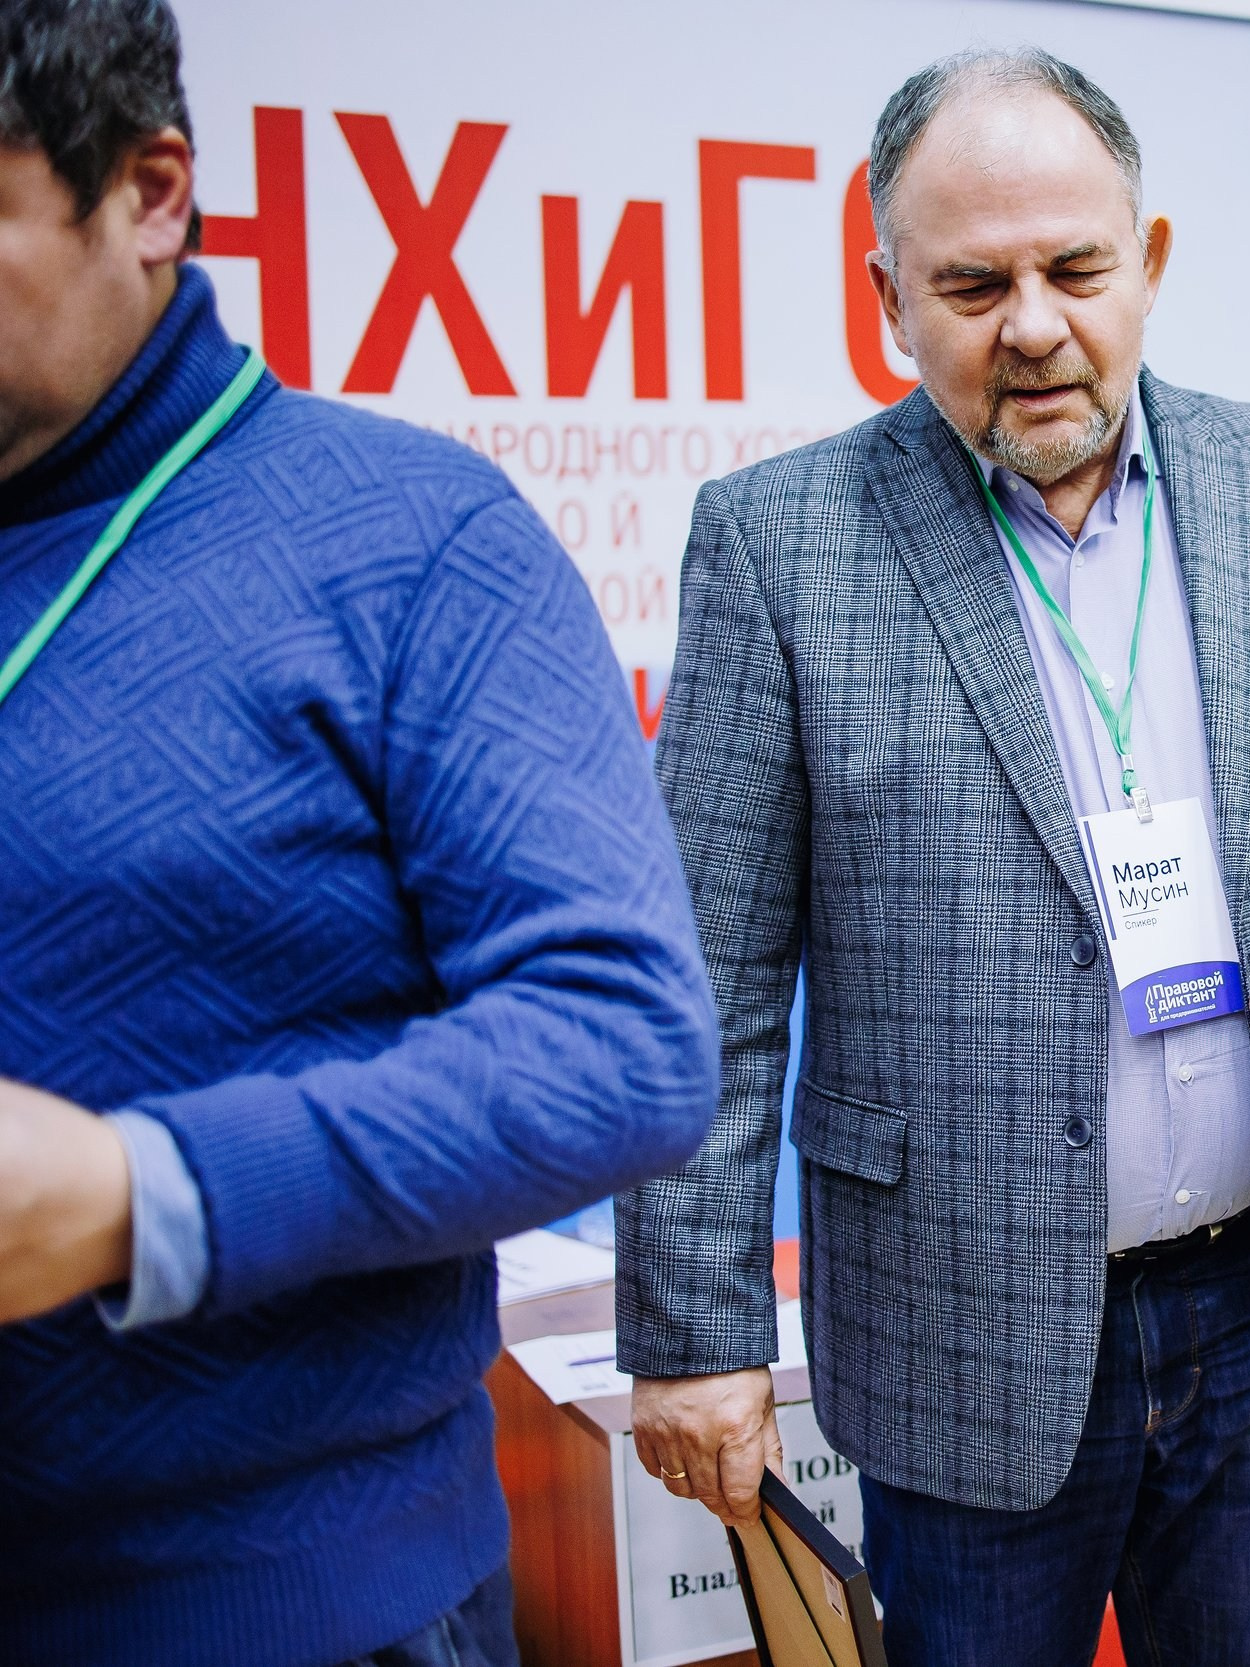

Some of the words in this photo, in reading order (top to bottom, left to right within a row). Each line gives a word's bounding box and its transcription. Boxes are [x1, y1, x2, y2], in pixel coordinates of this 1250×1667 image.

[1112, 856, 1182, 884] Марат
[1119, 881, 1189, 909] Мусин
[1124, 916, 1158, 930] Спикер
[1152, 970, 1225, 1000] Правовой
[1158, 988, 1217, 1014] диктант
